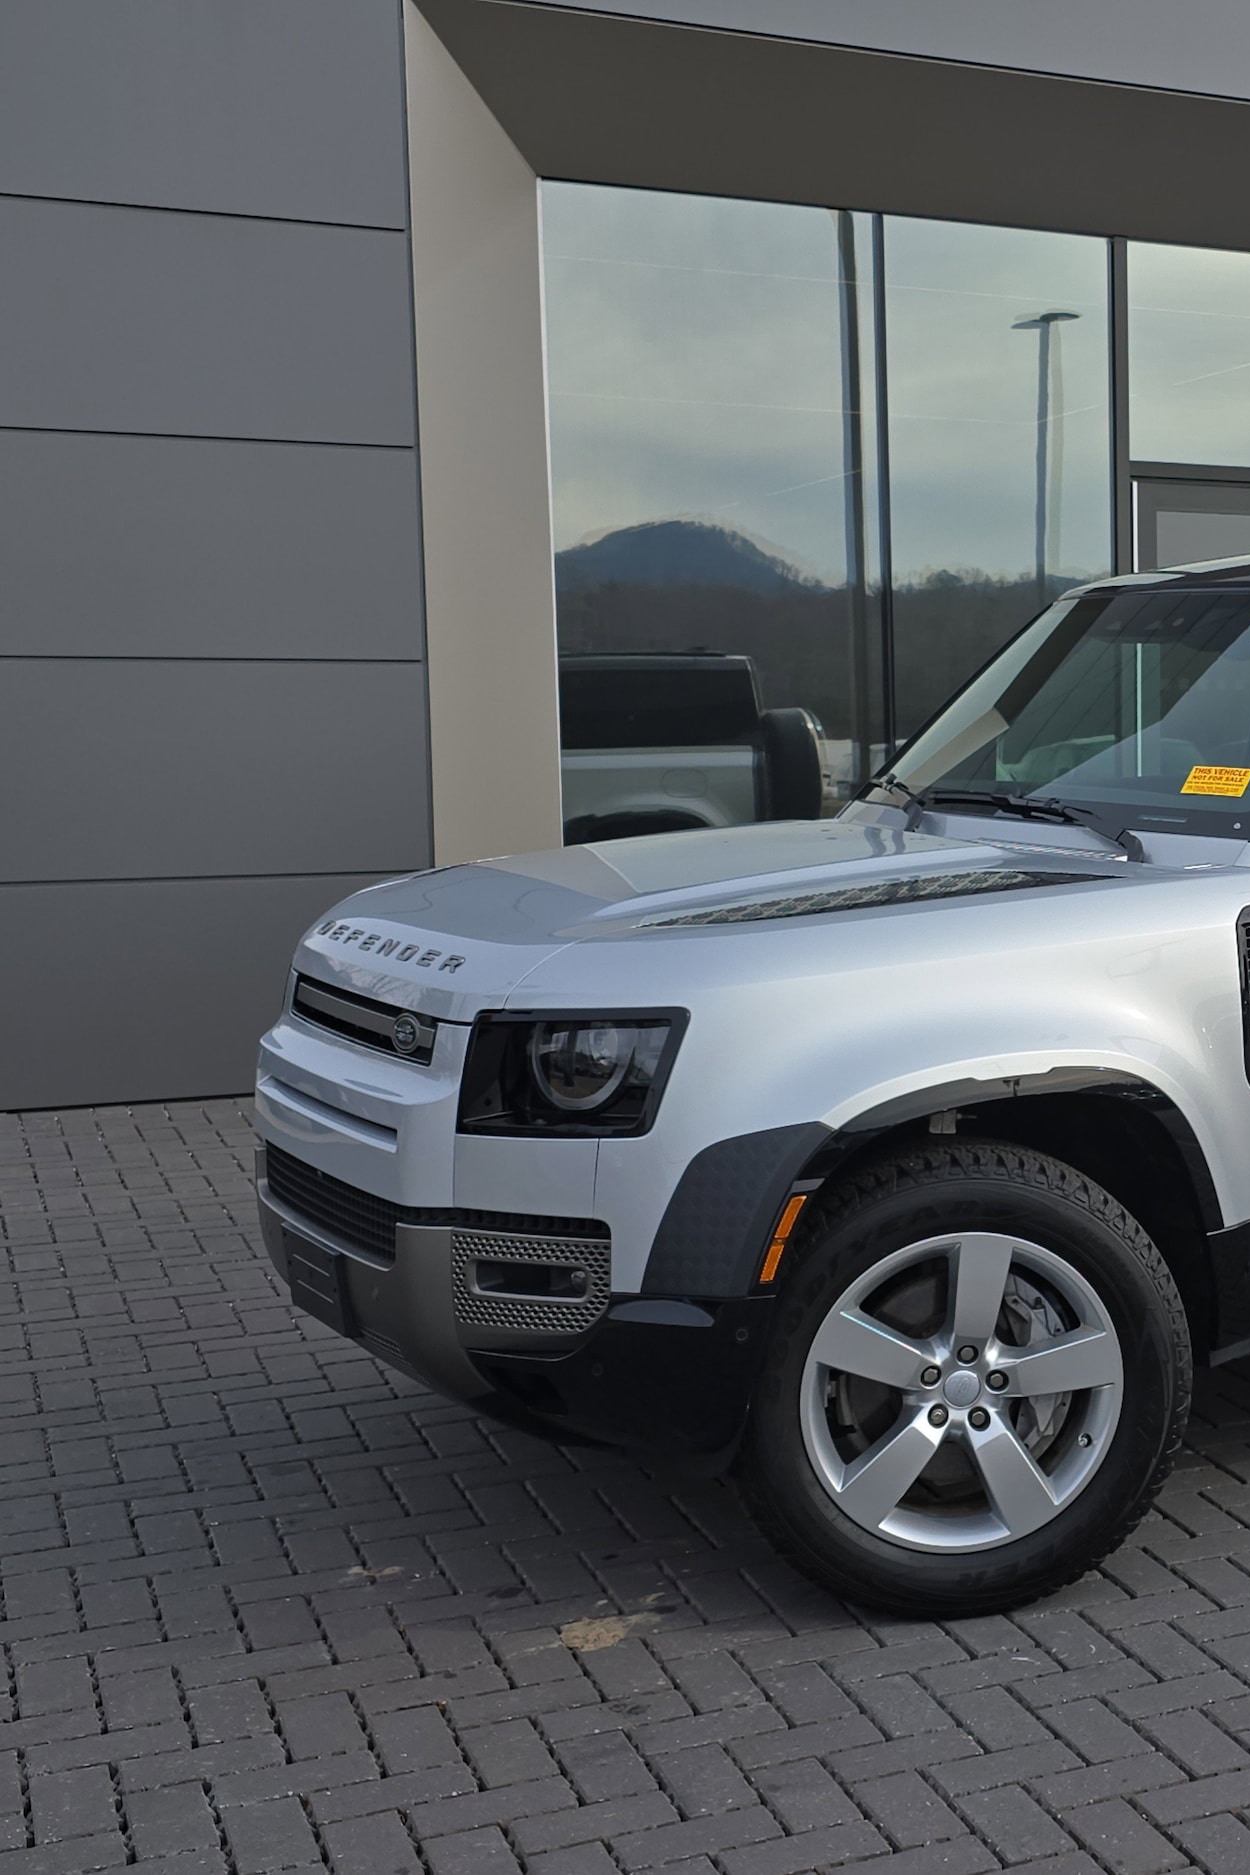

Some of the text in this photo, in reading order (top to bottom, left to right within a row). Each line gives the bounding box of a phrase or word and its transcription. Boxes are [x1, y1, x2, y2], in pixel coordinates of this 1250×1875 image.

[1193, 767, 1249, 777] THIS VEHICLE
[316, 919, 466, 974] DEFENDER
